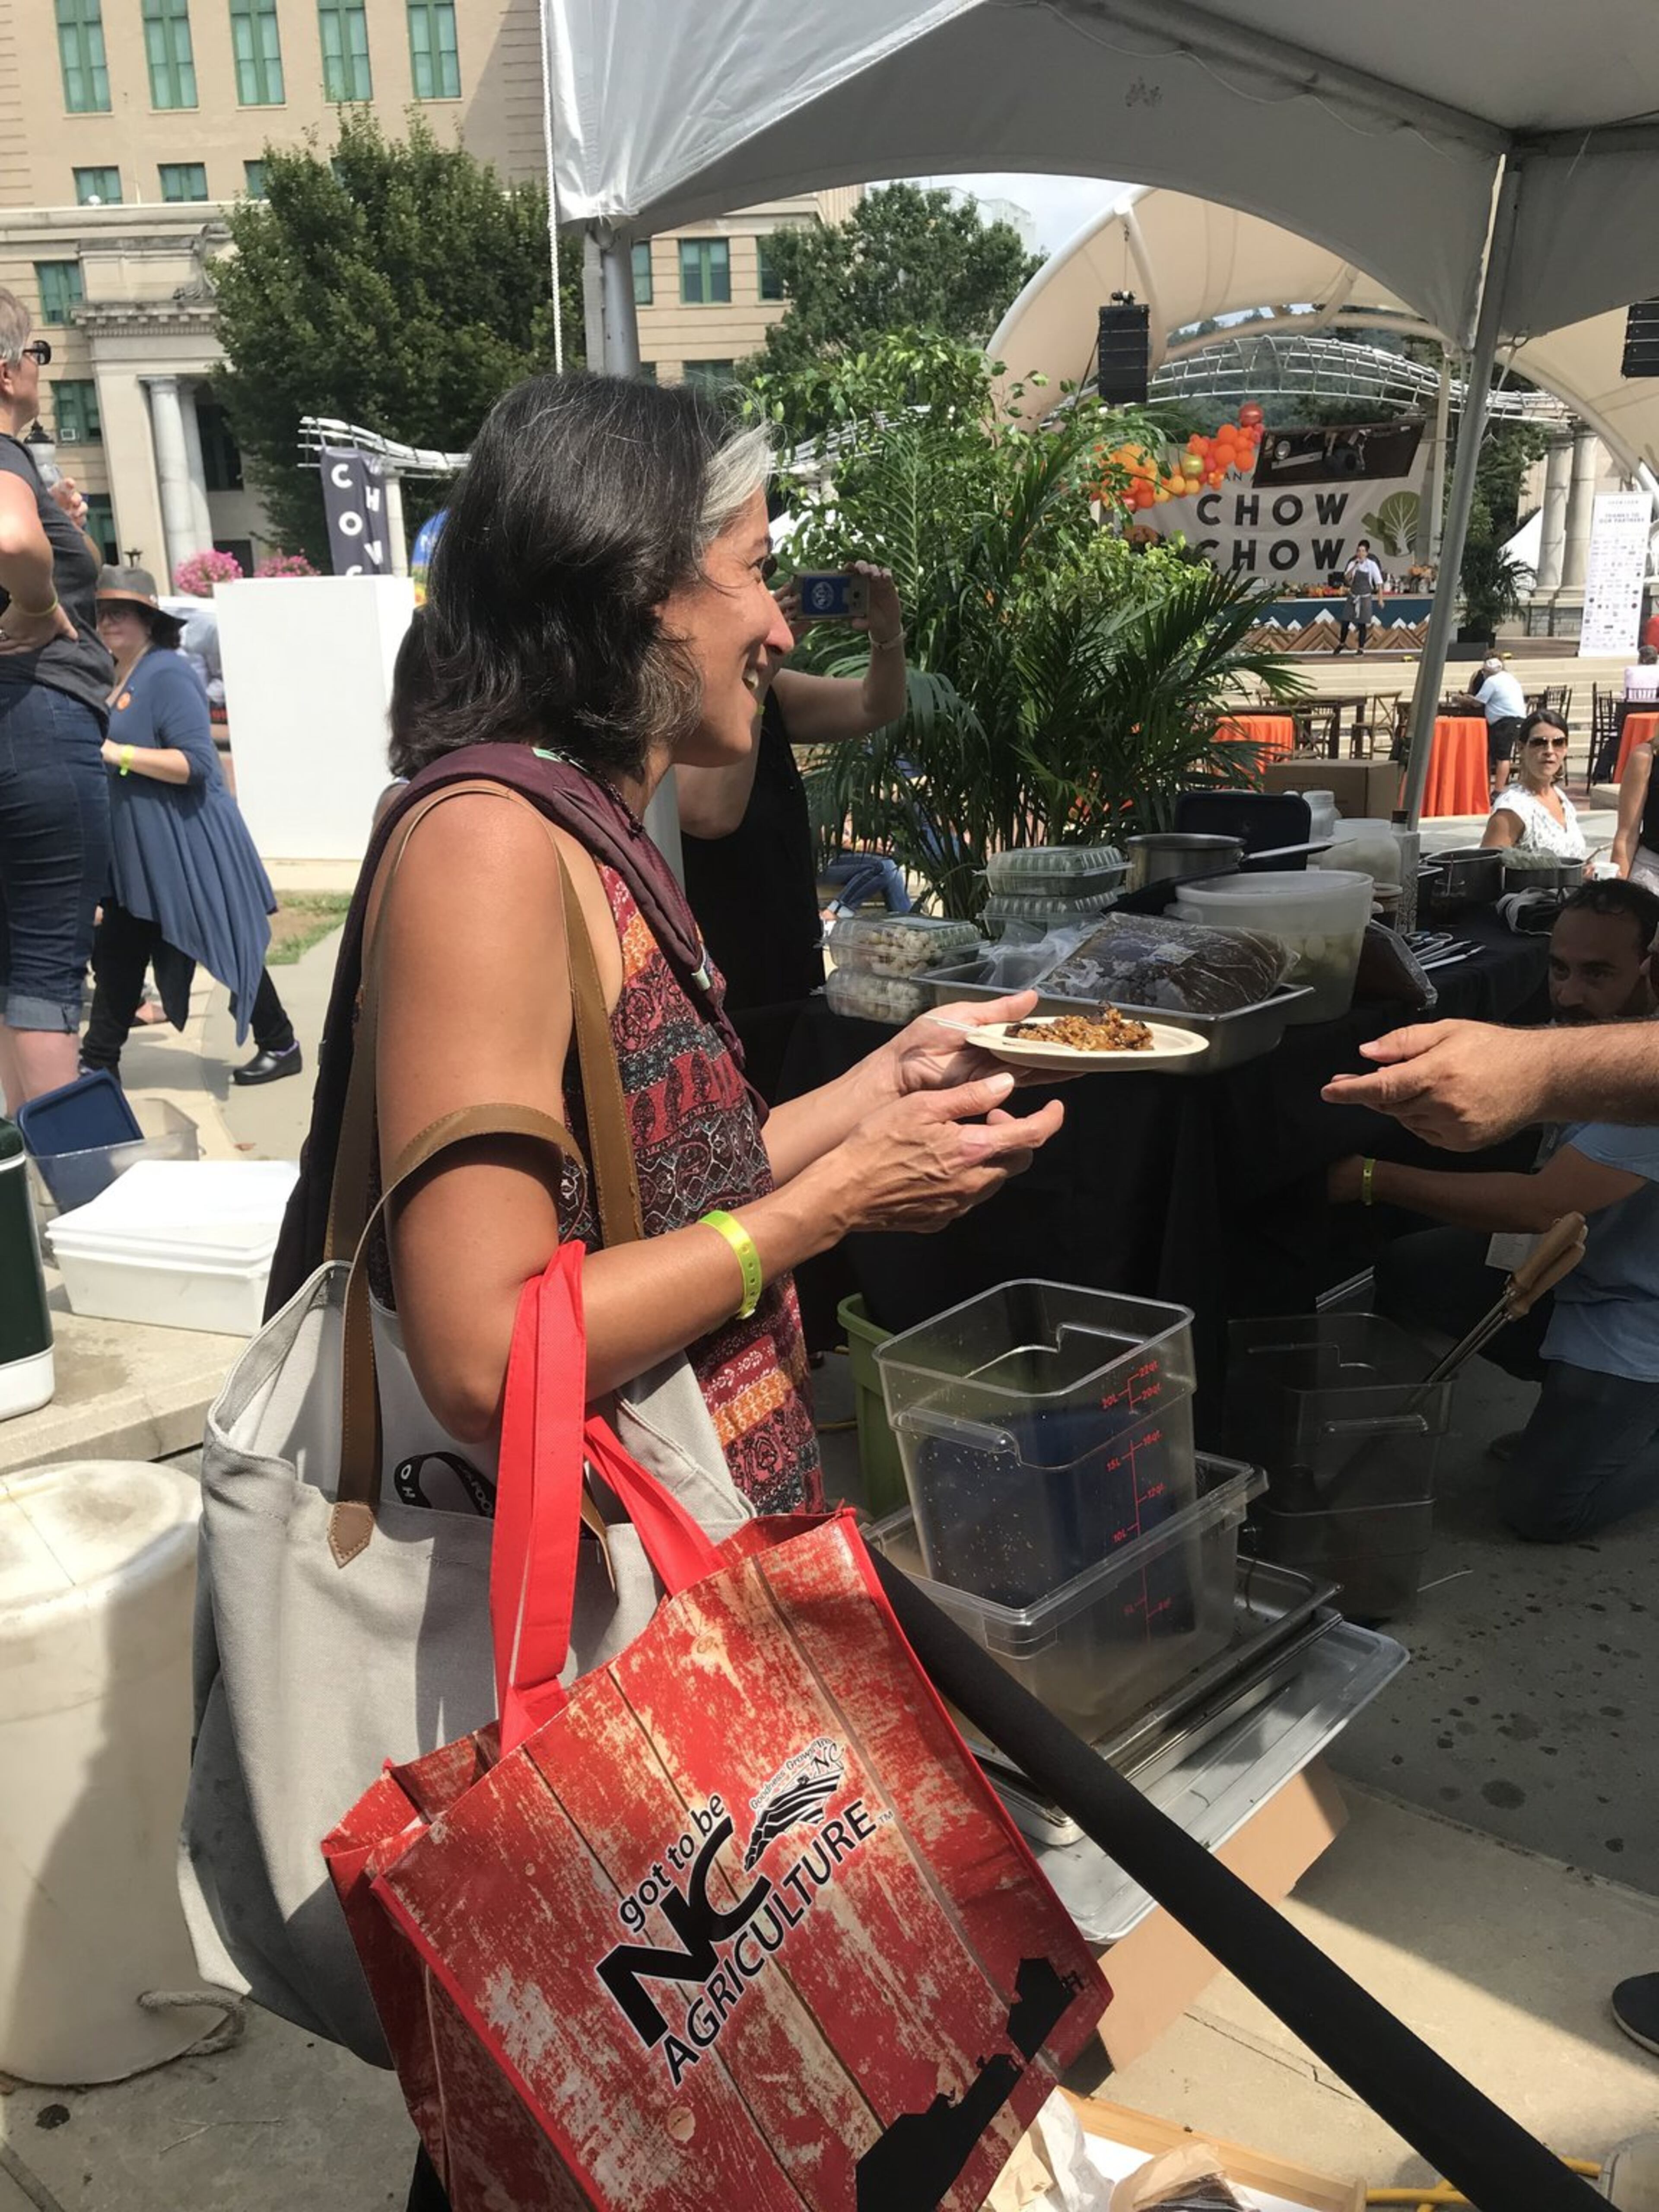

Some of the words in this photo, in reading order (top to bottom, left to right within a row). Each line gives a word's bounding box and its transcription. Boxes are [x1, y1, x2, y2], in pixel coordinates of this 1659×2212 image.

[1197, 493, 1348, 526] CHOW
[597, 1816, 771, 2048] NC
[620, 1864, 672, 1933] got
[667, 1834, 695, 1870] to
[690, 1795, 725, 1837] be
[664, 1800, 877, 2085] AGRICULTURE
